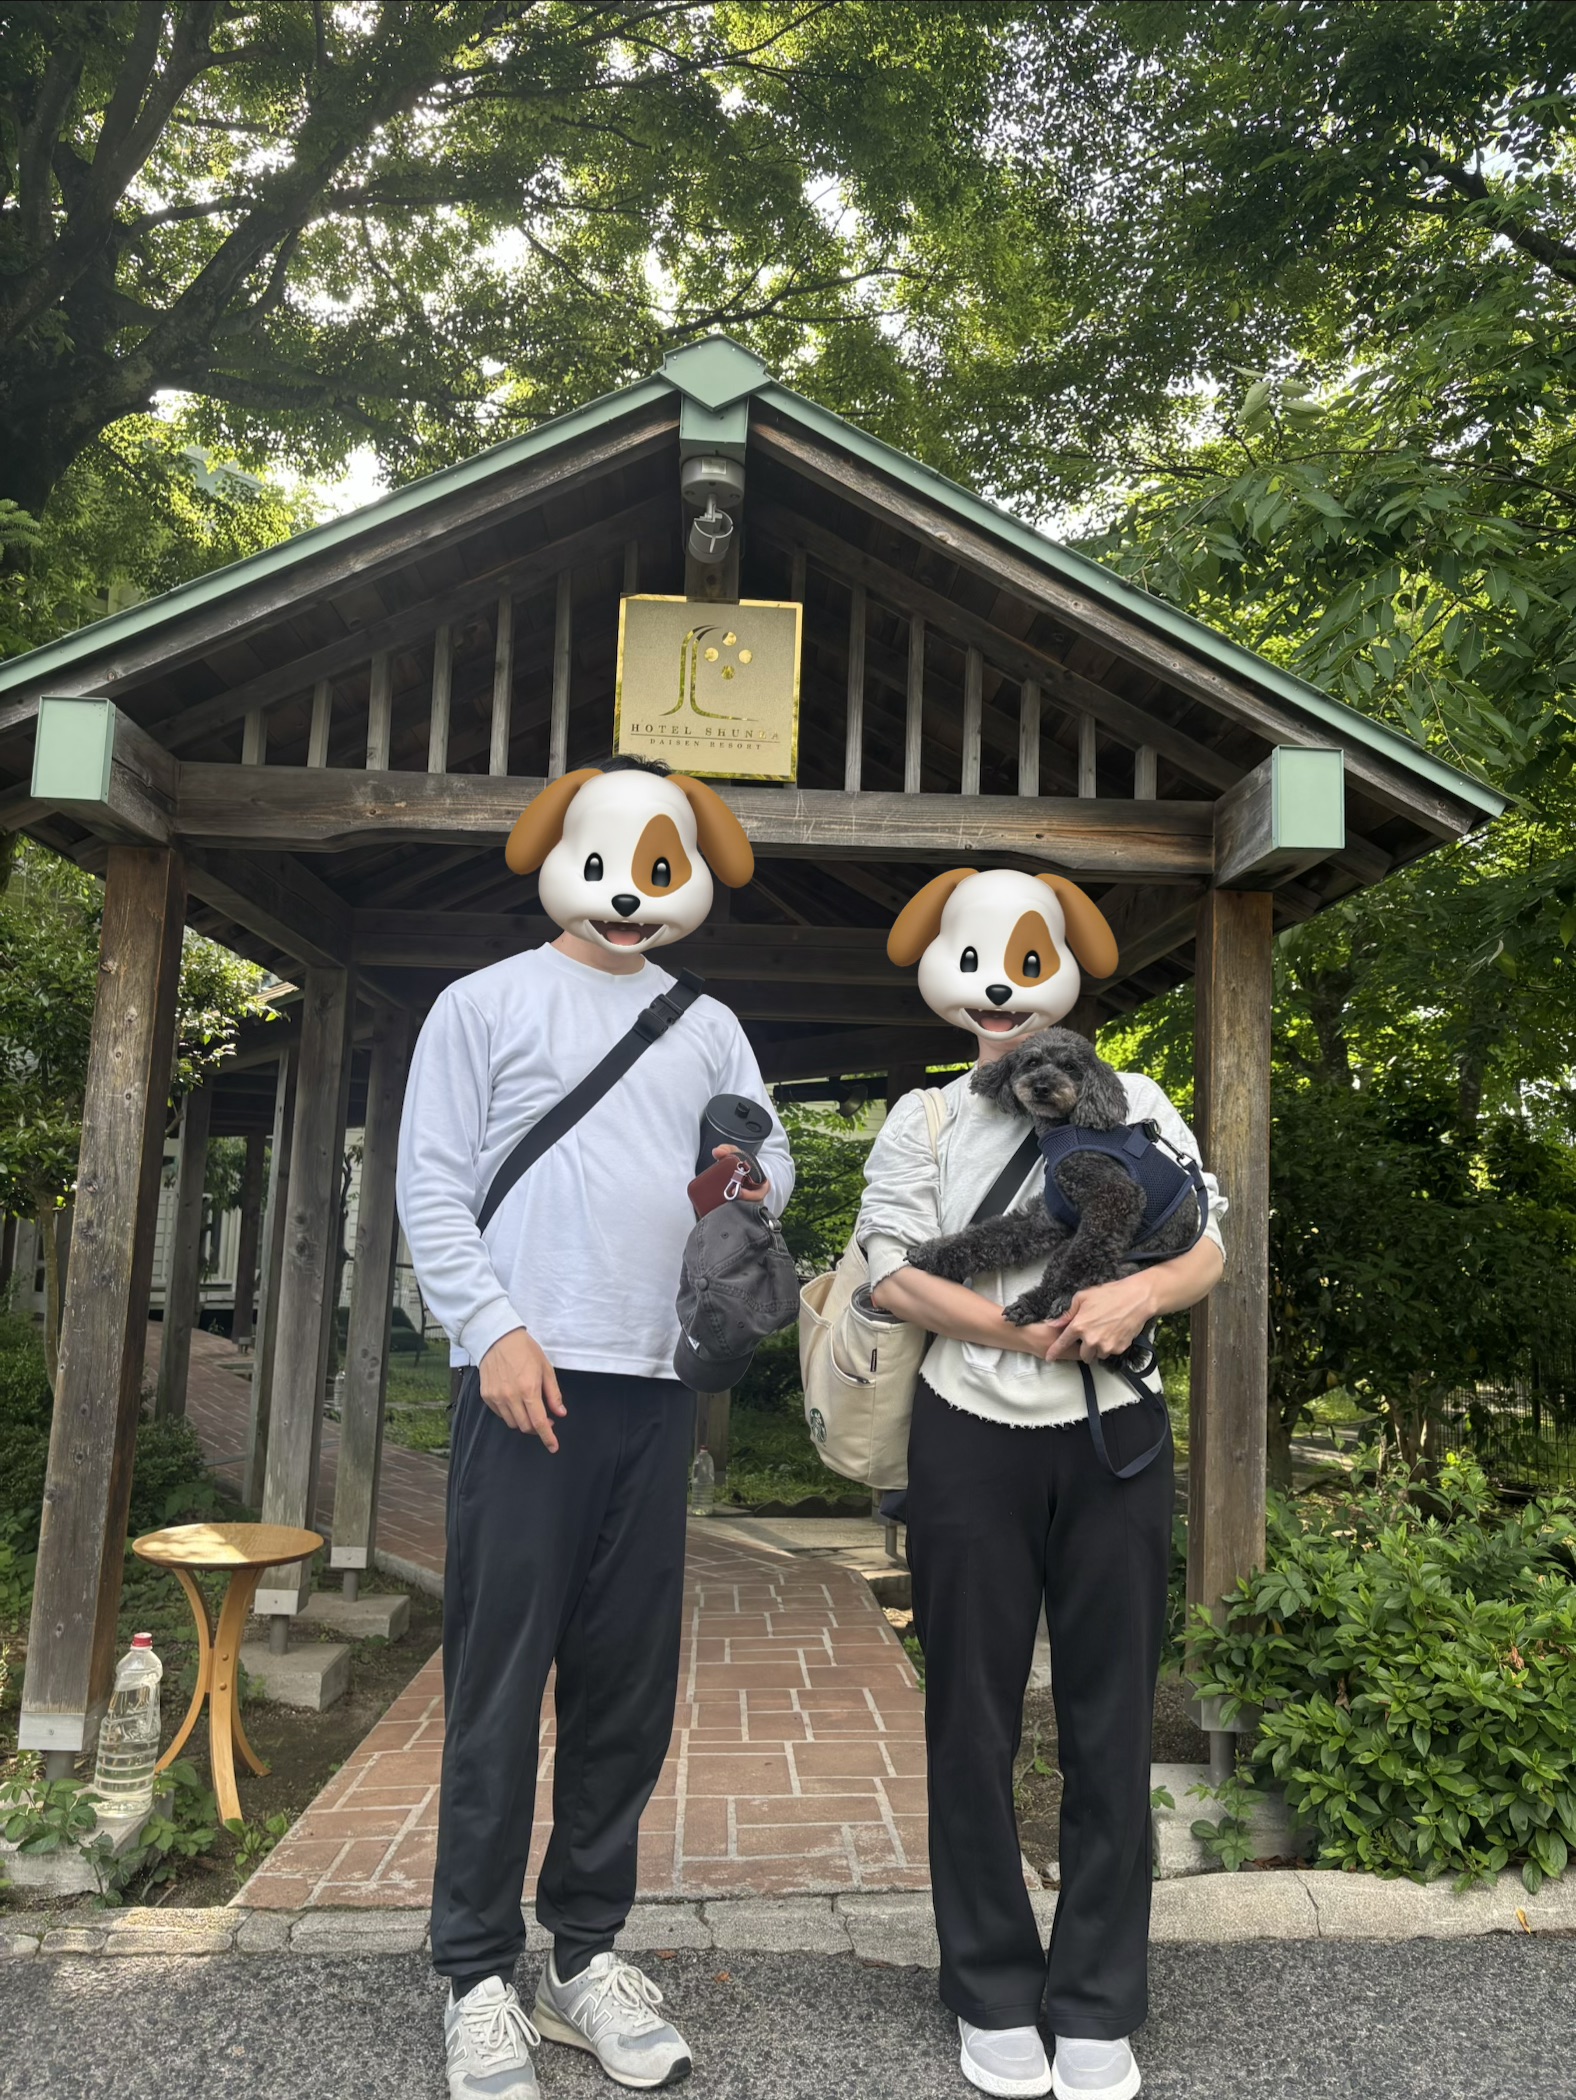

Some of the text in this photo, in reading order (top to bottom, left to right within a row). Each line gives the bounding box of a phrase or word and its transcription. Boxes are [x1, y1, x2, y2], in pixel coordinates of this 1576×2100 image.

[631, 723, 780, 740] HOTEL SHUNZA
[650, 738, 762, 750] DAISEN RESORT
[571, 1993, 613, 2042] N
